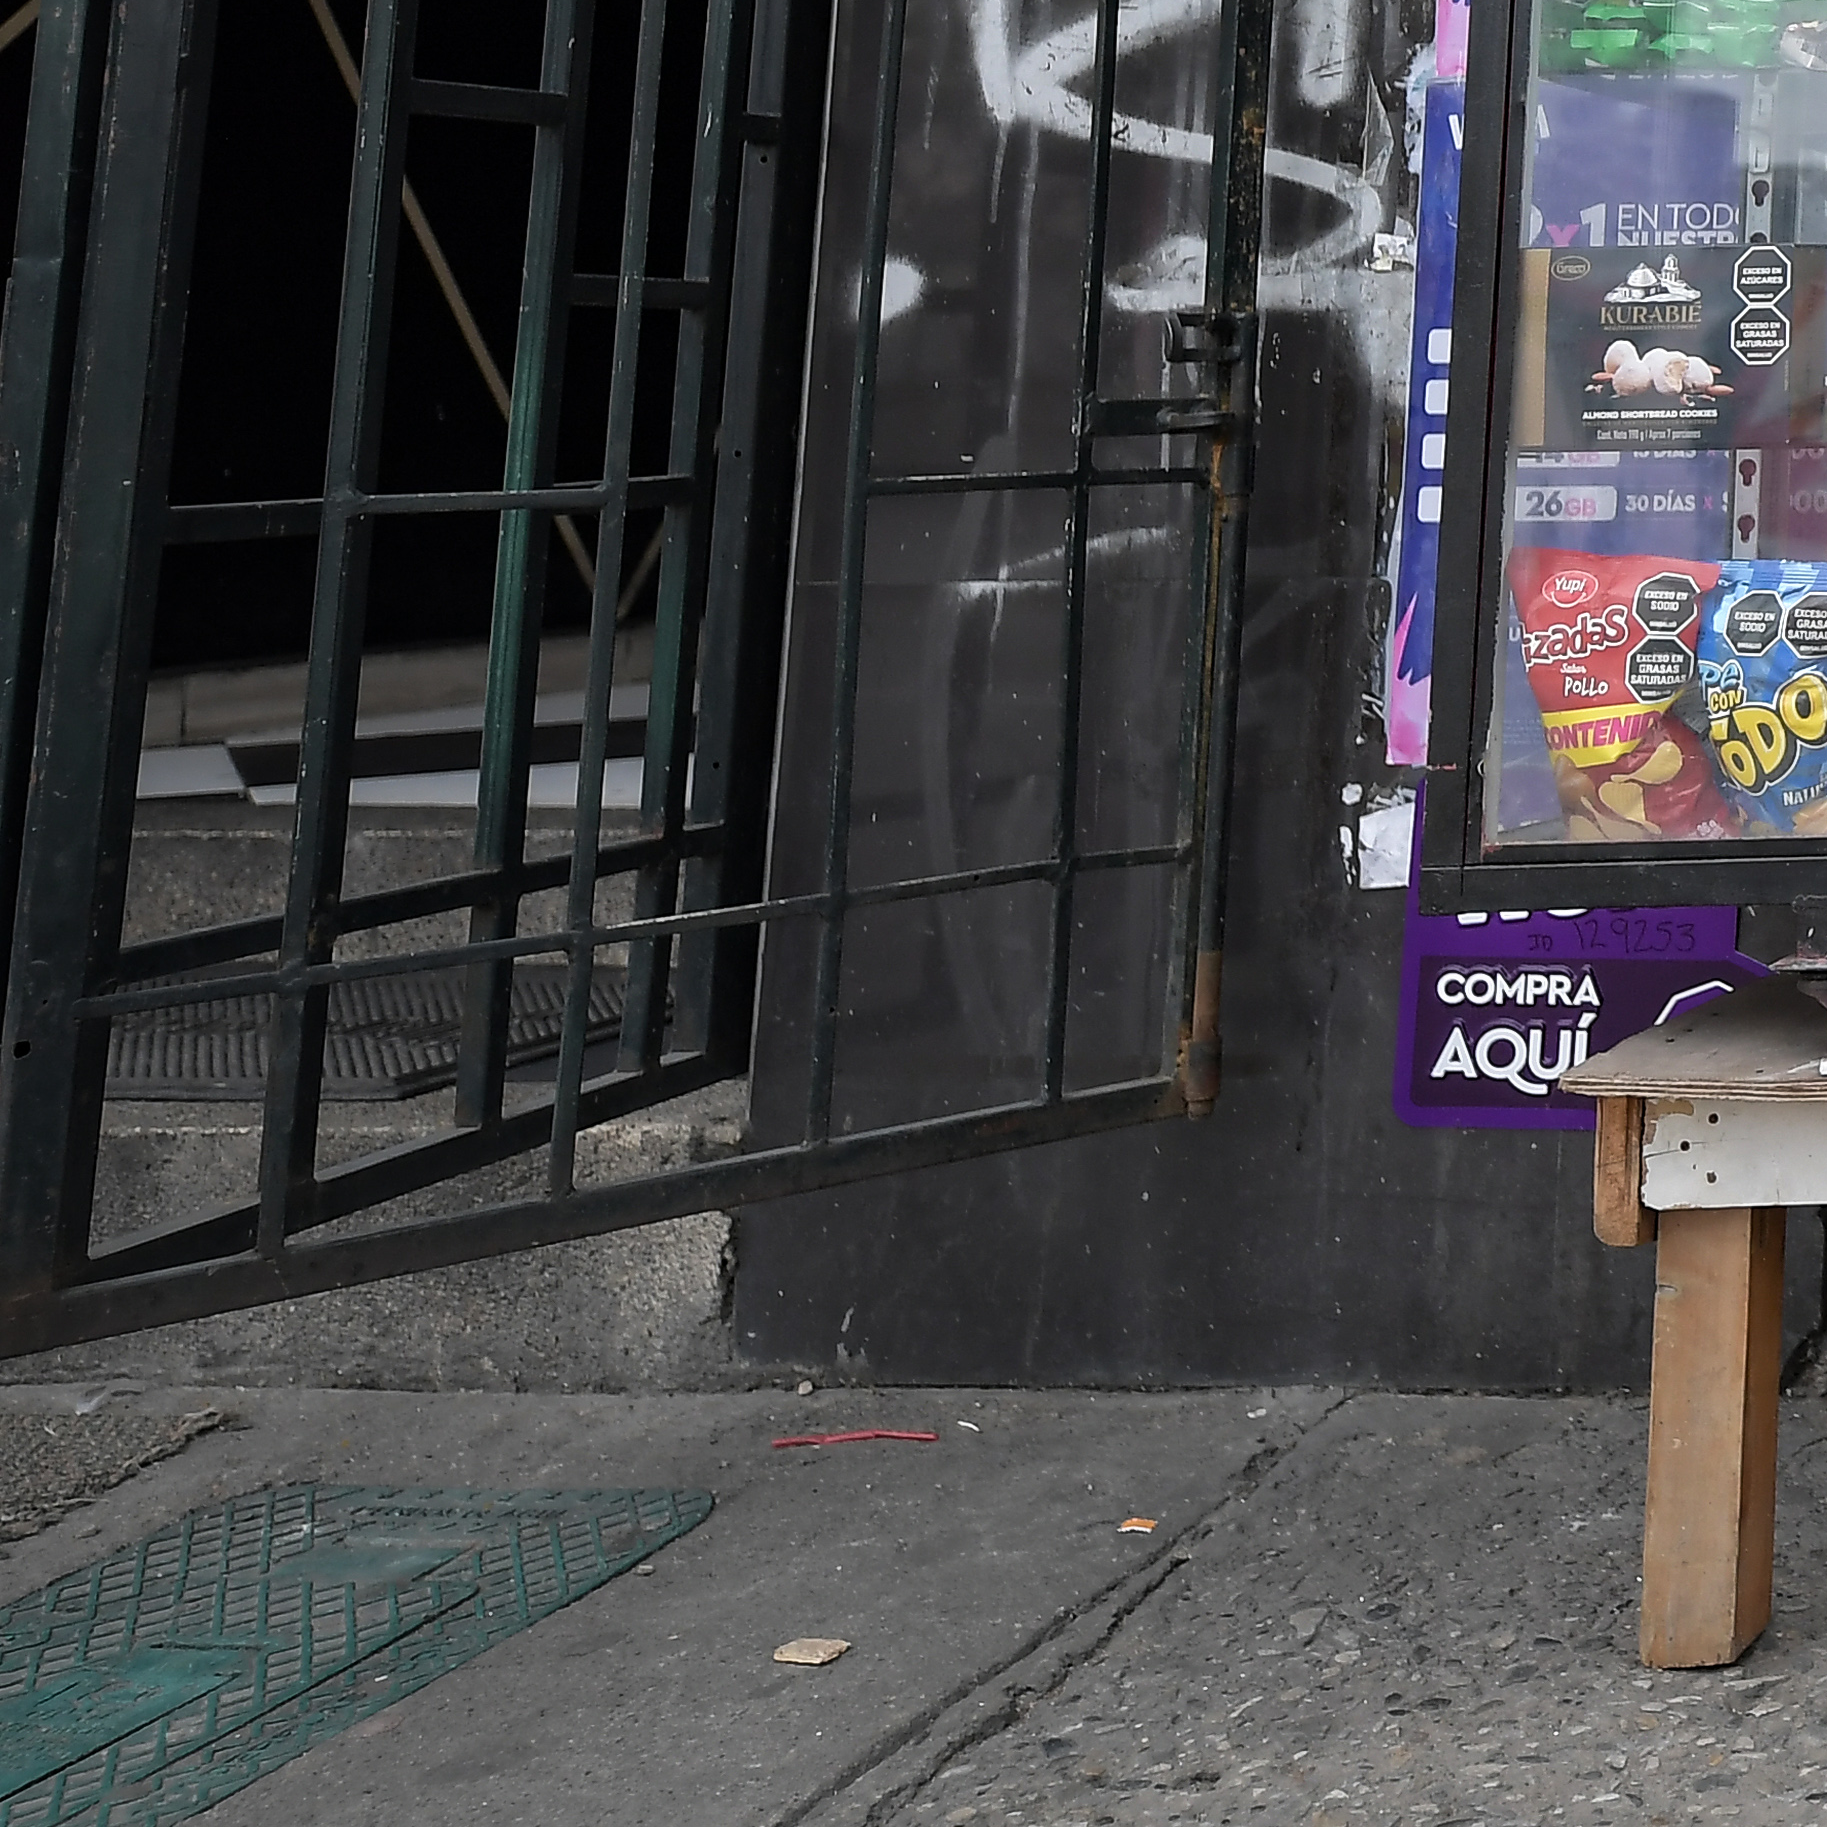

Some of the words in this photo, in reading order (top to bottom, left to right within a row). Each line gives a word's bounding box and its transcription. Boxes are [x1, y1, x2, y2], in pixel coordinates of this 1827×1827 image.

[1618, 204, 1658, 229] EN
[1743, 267, 1770, 276] EXCESO
[1772, 267, 1782, 275] EN
[1741, 322, 1769, 331] EXCESO
[1770, 322, 1781, 330] EN
[1743, 329, 1777, 339] GRASAS
[1735, 338, 1785, 349] SATURADAS
[1582, 410, 1619, 420] ALMOND
[1620, 409, 1678, 420] SHORTBREAD
[1679, 408, 1718, 419] COOKIES
[1525, 490, 1597, 518] 26GB
[1625, 494, 1650, 512] 30
[1653, 489, 1696, 512] DÍAS
[1554, 577, 1586, 593] Yupi
[1645, 591, 1674, 601] EXCESO
[1676, 591, 1688, 600] EN
[1650, 600, 1679, 612] SODIO
[1735, 612, 1763, 621] EXCESO
[1765, 612, 1776, 621] EN
[1795, 609, 1827, 619] EXCESO
[1739, 622, 1766, 633] SODIO
[1637, 655, 1669, 664] EXCESO
[1671, 654, 1684, 663] EN
[1639, 663, 1680, 675] GRASAS
[1631, 673, 1686, 685] SATURADAS
[1565, 676, 1609, 696] POLLO
[1436, 972, 1602, 1006] COMPRA
[1430, 1012, 1597, 1096] AQUÍ
